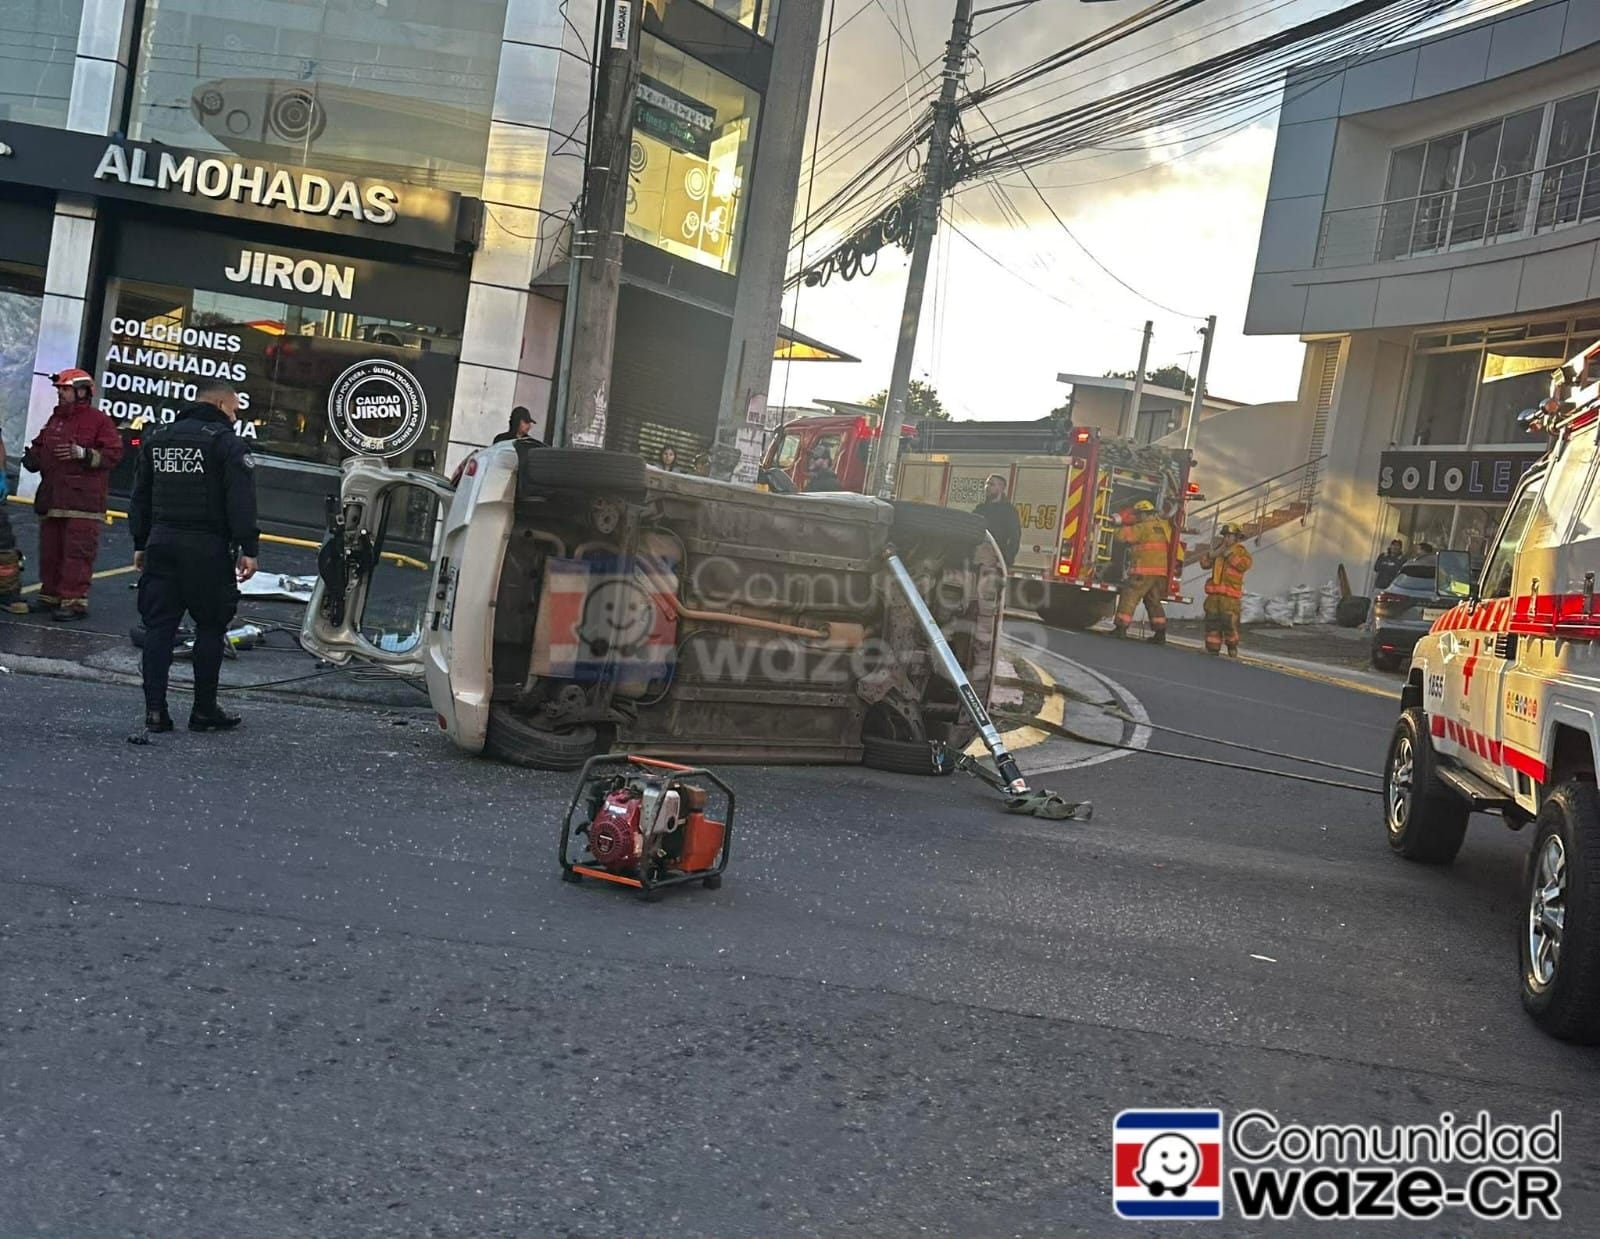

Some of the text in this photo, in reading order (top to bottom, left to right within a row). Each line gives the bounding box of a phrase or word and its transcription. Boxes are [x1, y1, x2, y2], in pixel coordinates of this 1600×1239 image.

[94, 144, 398, 224] ALMOHADAS
[224, 249, 355, 300] JIRON
[110, 317, 242, 353] COLCHONES
[105, 345, 246, 382] ALMOHADAS
[98, 398, 157, 424] ROPA
[352, 405, 401, 419] JIRON
[356, 395, 400, 405] CALIDAD
[152, 448, 205, 461] FUERZA
[152, 460, 205, 474] PUBLICA
